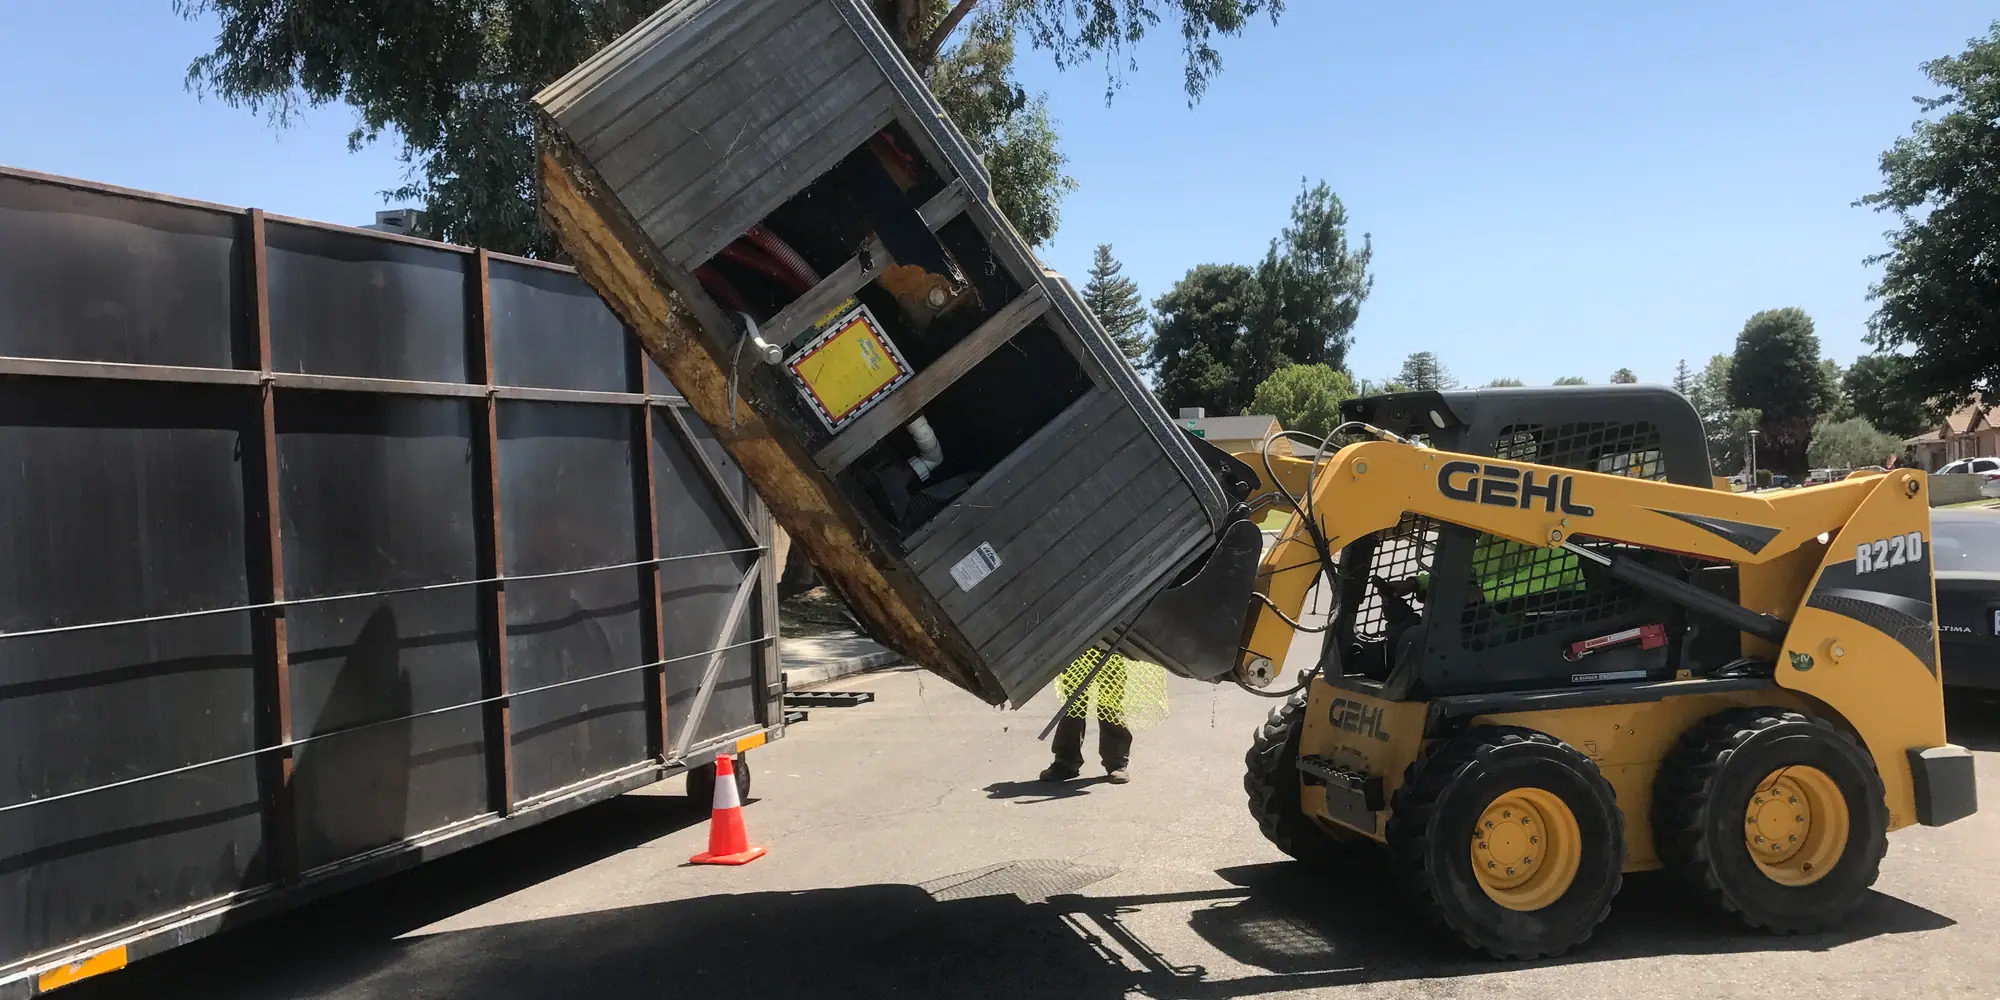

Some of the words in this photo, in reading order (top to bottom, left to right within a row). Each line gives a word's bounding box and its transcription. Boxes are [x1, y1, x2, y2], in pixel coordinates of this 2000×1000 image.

[1437, 460, 1594, 517] GEHL
[1856, 531, 1922, 576] R220
[1937, 625, 1972, 633] LTIMA
[1329, 697, 1390, 743] GEHL
